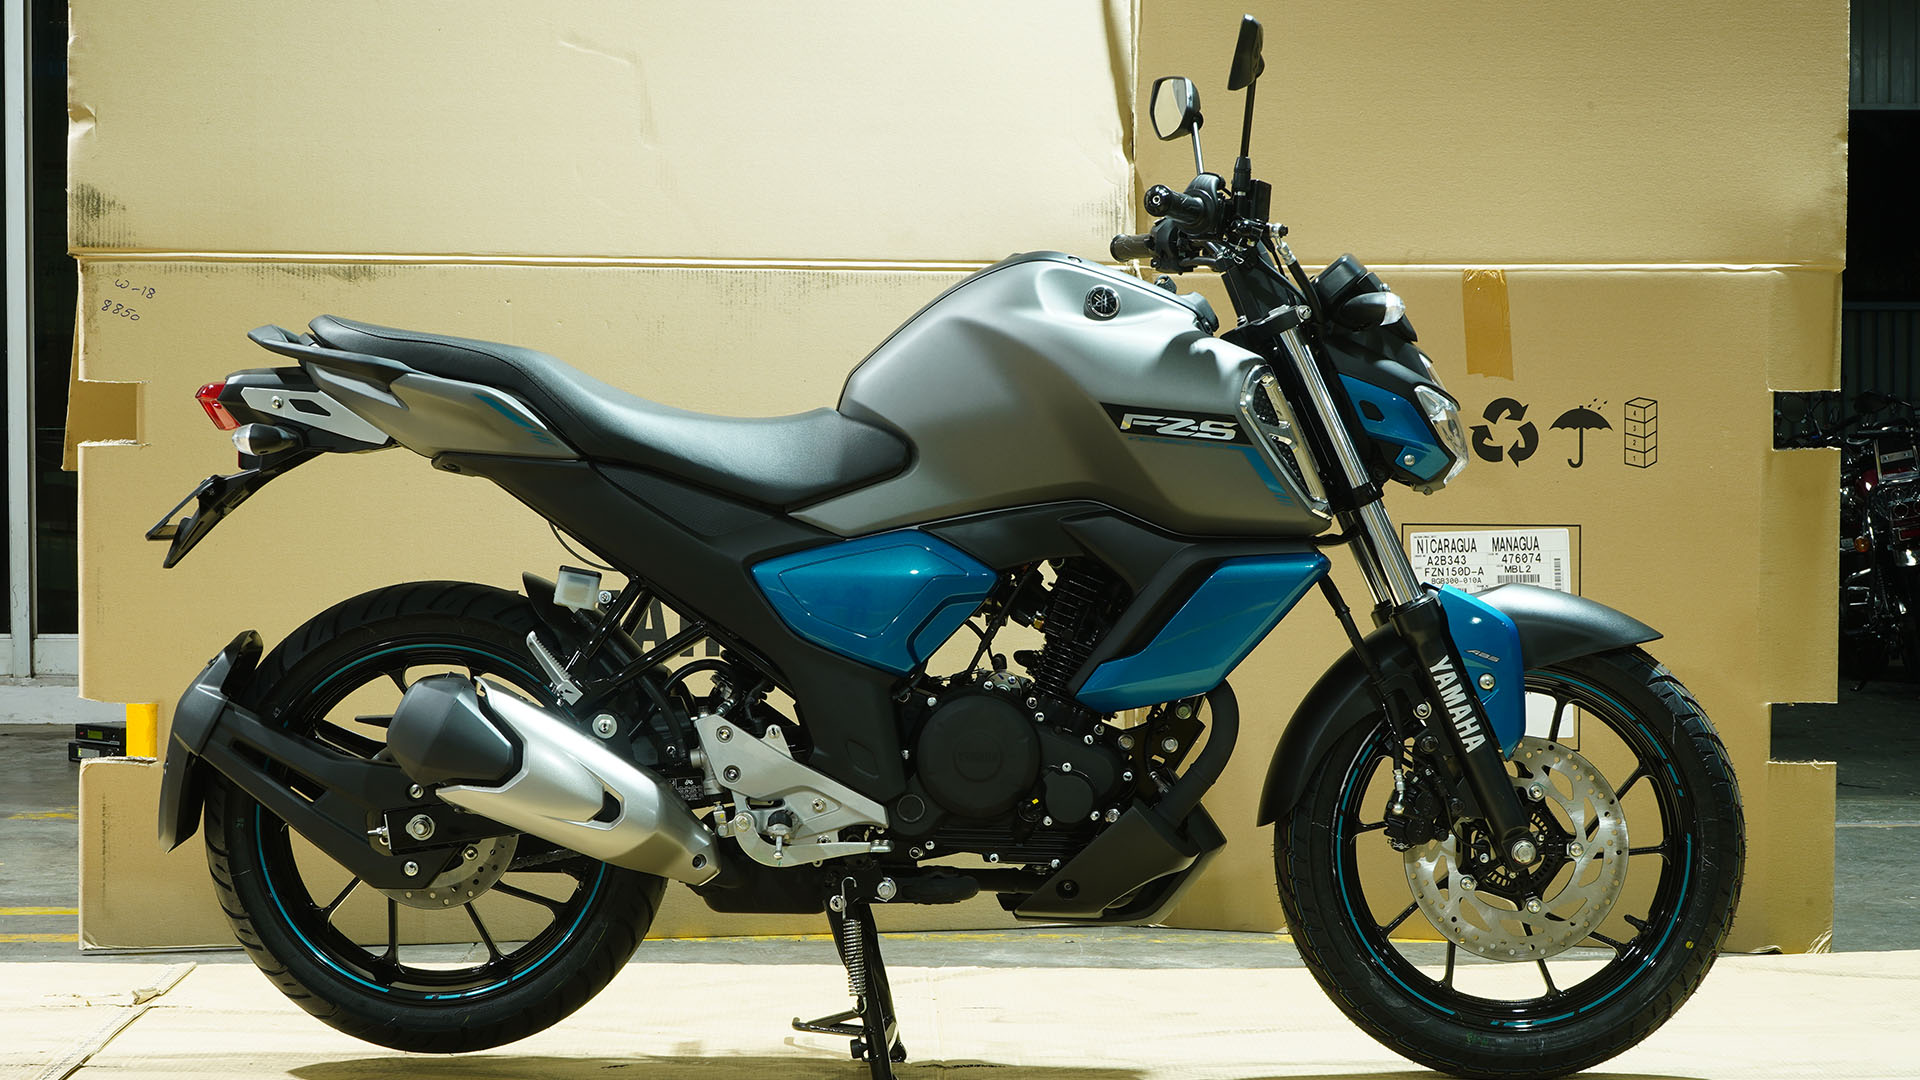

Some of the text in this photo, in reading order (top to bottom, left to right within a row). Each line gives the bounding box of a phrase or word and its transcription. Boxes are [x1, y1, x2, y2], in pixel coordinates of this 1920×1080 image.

[101, 299, 140, 321] 8850
[1416, 536, 1540, 554] NICARAGUA MANAGUA
[1427, 554, 1467, 566] A2B343
[1501, 552, 1541, 564] 476074
[1424, 566, 1484, 577] FZN150D-A
[1504, 565, 1532, 573] MBL2
[1429, 655, 1486, 754] YAMAHA
